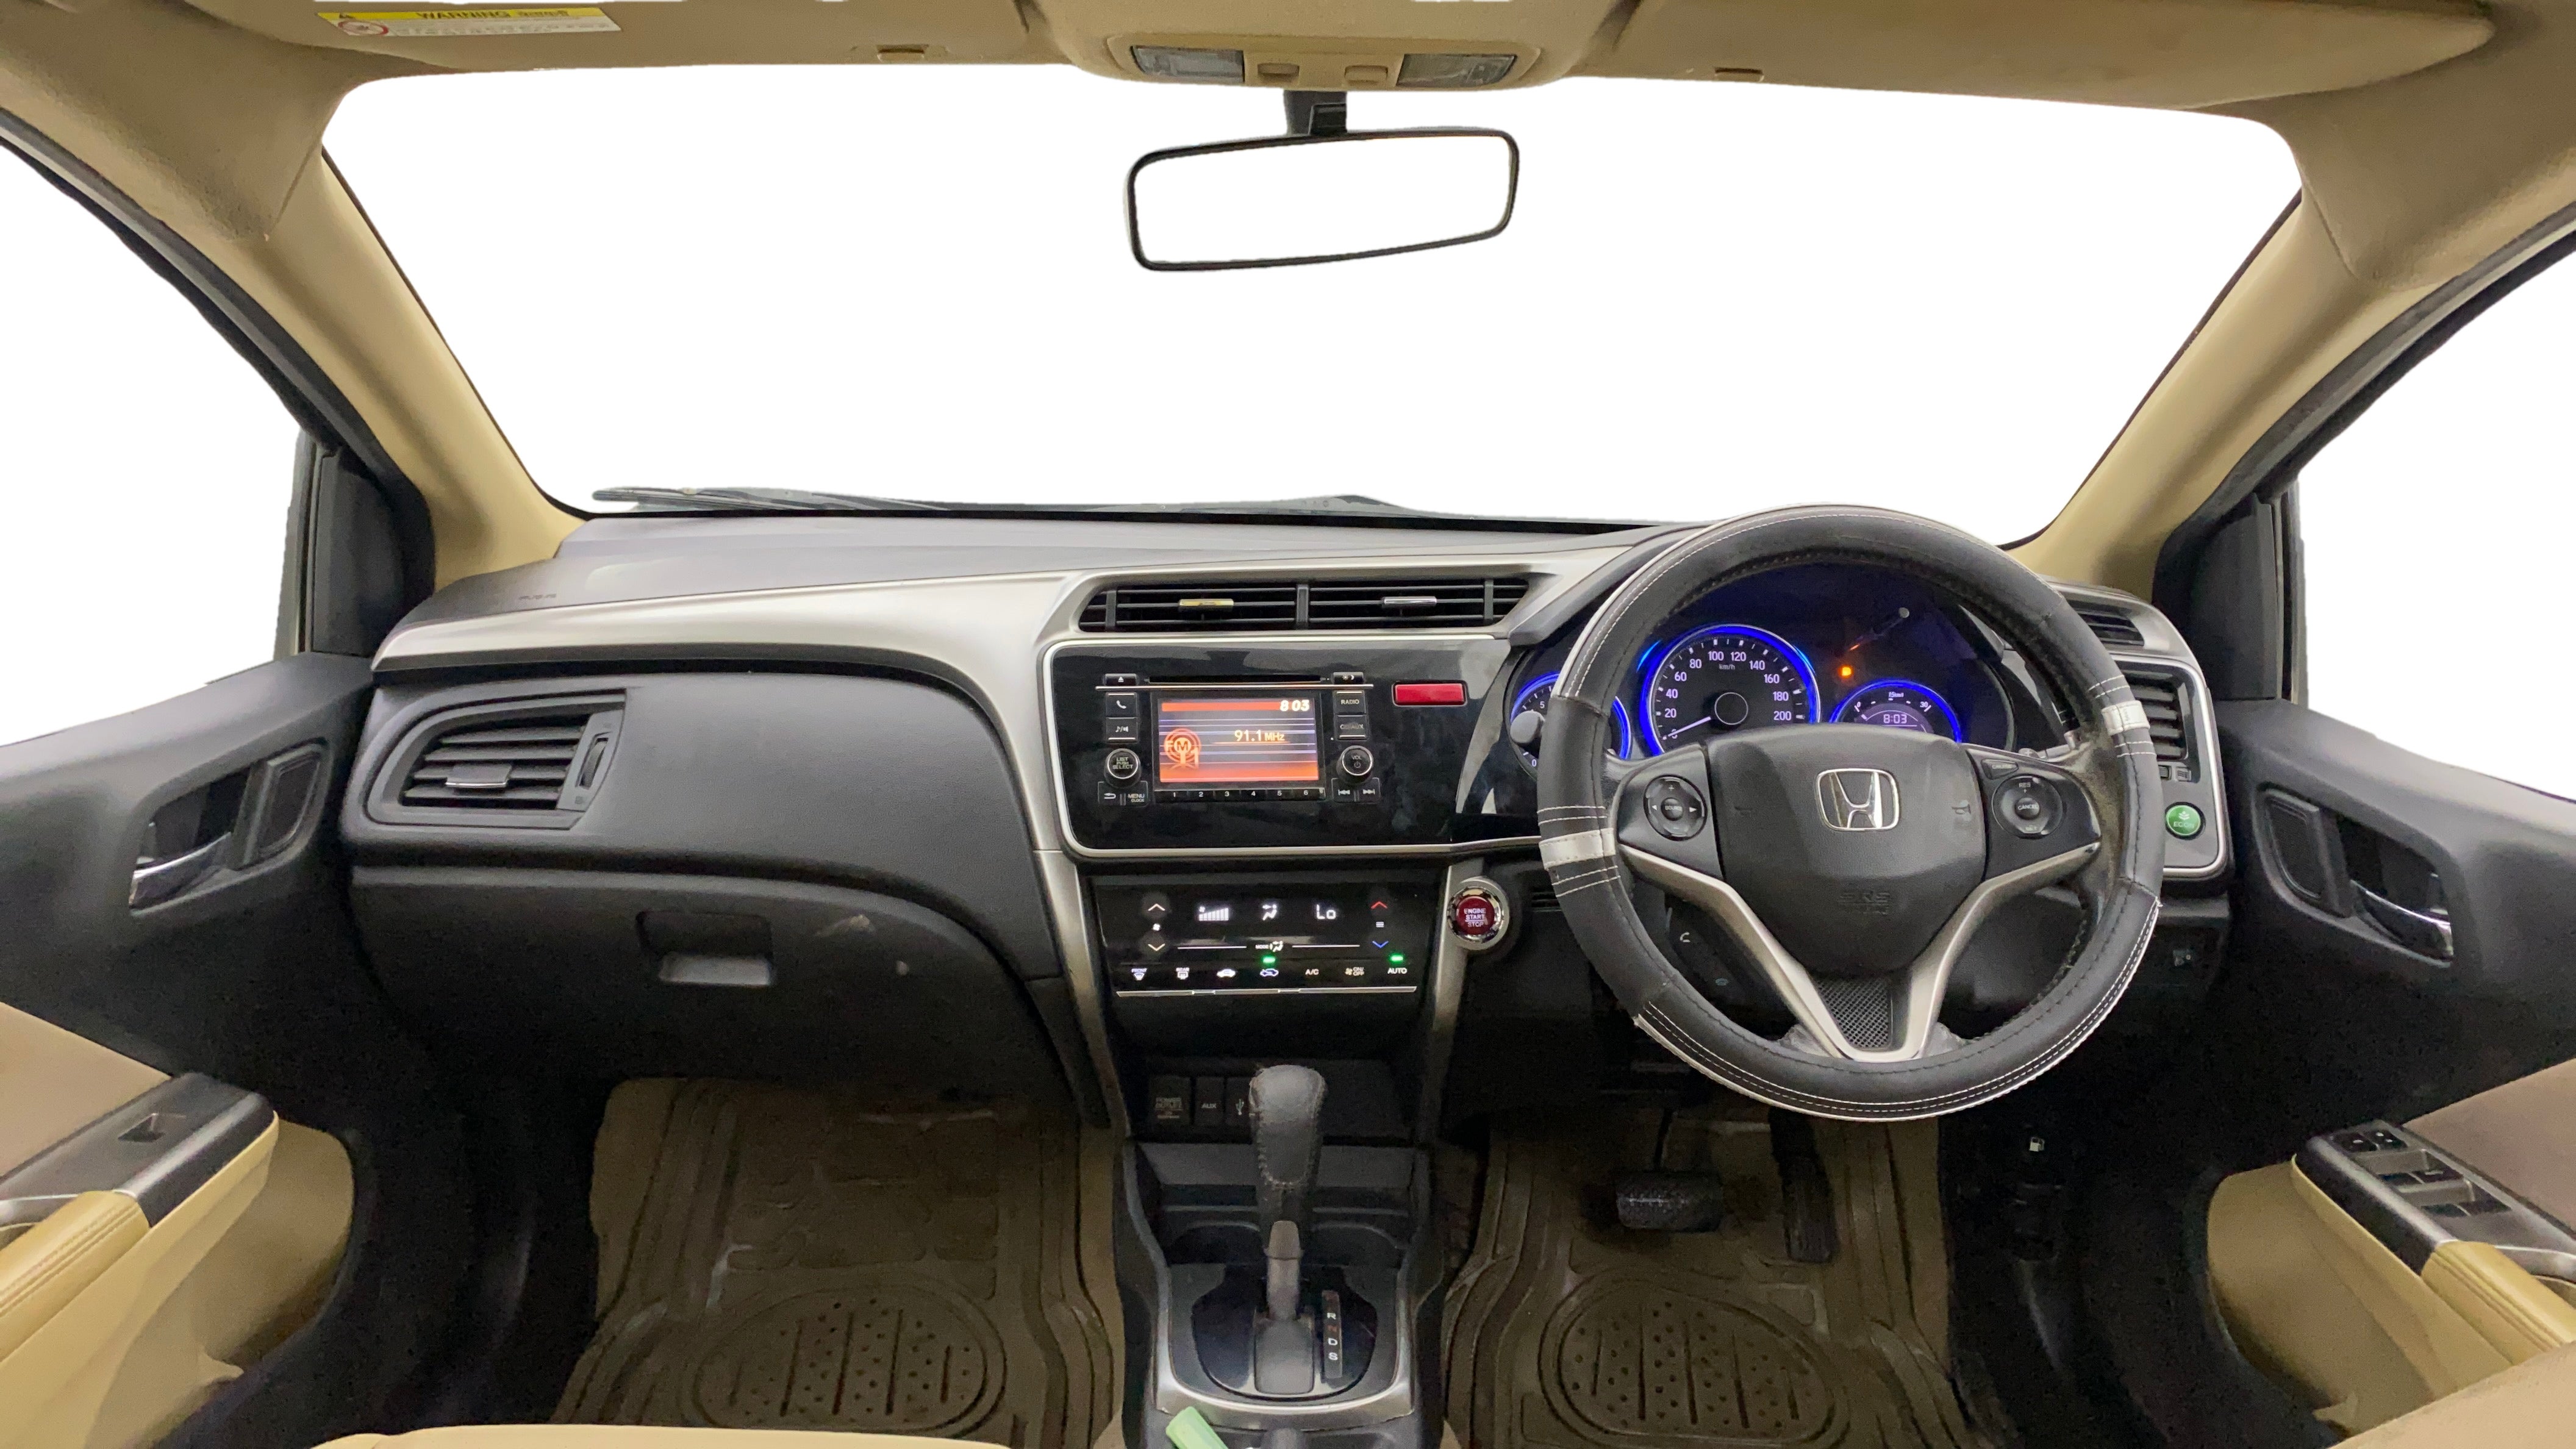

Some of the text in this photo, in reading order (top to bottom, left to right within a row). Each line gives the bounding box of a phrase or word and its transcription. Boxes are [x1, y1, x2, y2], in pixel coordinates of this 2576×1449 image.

[1708, 651, 1724, 661] 100
[1731, 651, 1747, 662] 120
[1689, 659, 1702, 669] 80
[1750, 660, 1766, 670] 140
[1674, 671, 1687, 682] 60
[1764, 673, 1780, 684] 160
[1665, 689, 1678, 699] 40
[1773, 691, 1789, 701] 180
[1664, 708, 1677, 718] 20
[1773, 711, 1792, 721] 200
[1883, 714, 1908, 724] 8:03
[1234, 729, 1286, 742] 91.1 MHz
[1316, 904, 1336, 920] Lo
[1328, 1337, 1338, 1346] D
[1328, 1352, 1338, 1361] S
